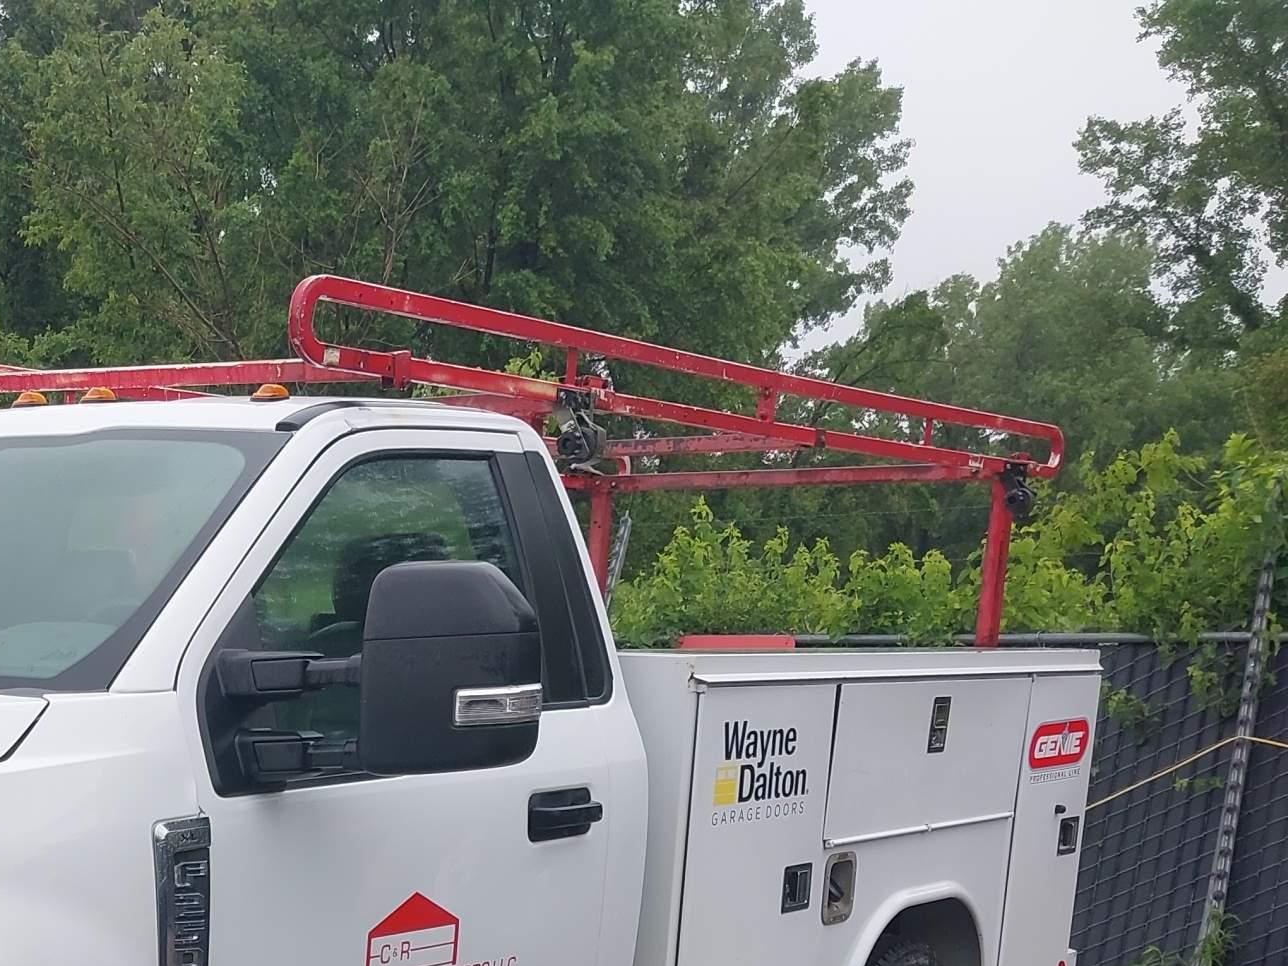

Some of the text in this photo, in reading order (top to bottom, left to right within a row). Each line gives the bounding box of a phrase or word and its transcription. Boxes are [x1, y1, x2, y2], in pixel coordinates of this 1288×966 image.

[724, 720, 797, 769] Wayne
[1034, 730, 1085, 759] GENIE
[712, 800, 804, 826] GARAGE DOORS
[380, 944, 391, 964] C
[400, 941, 411, 960] R
